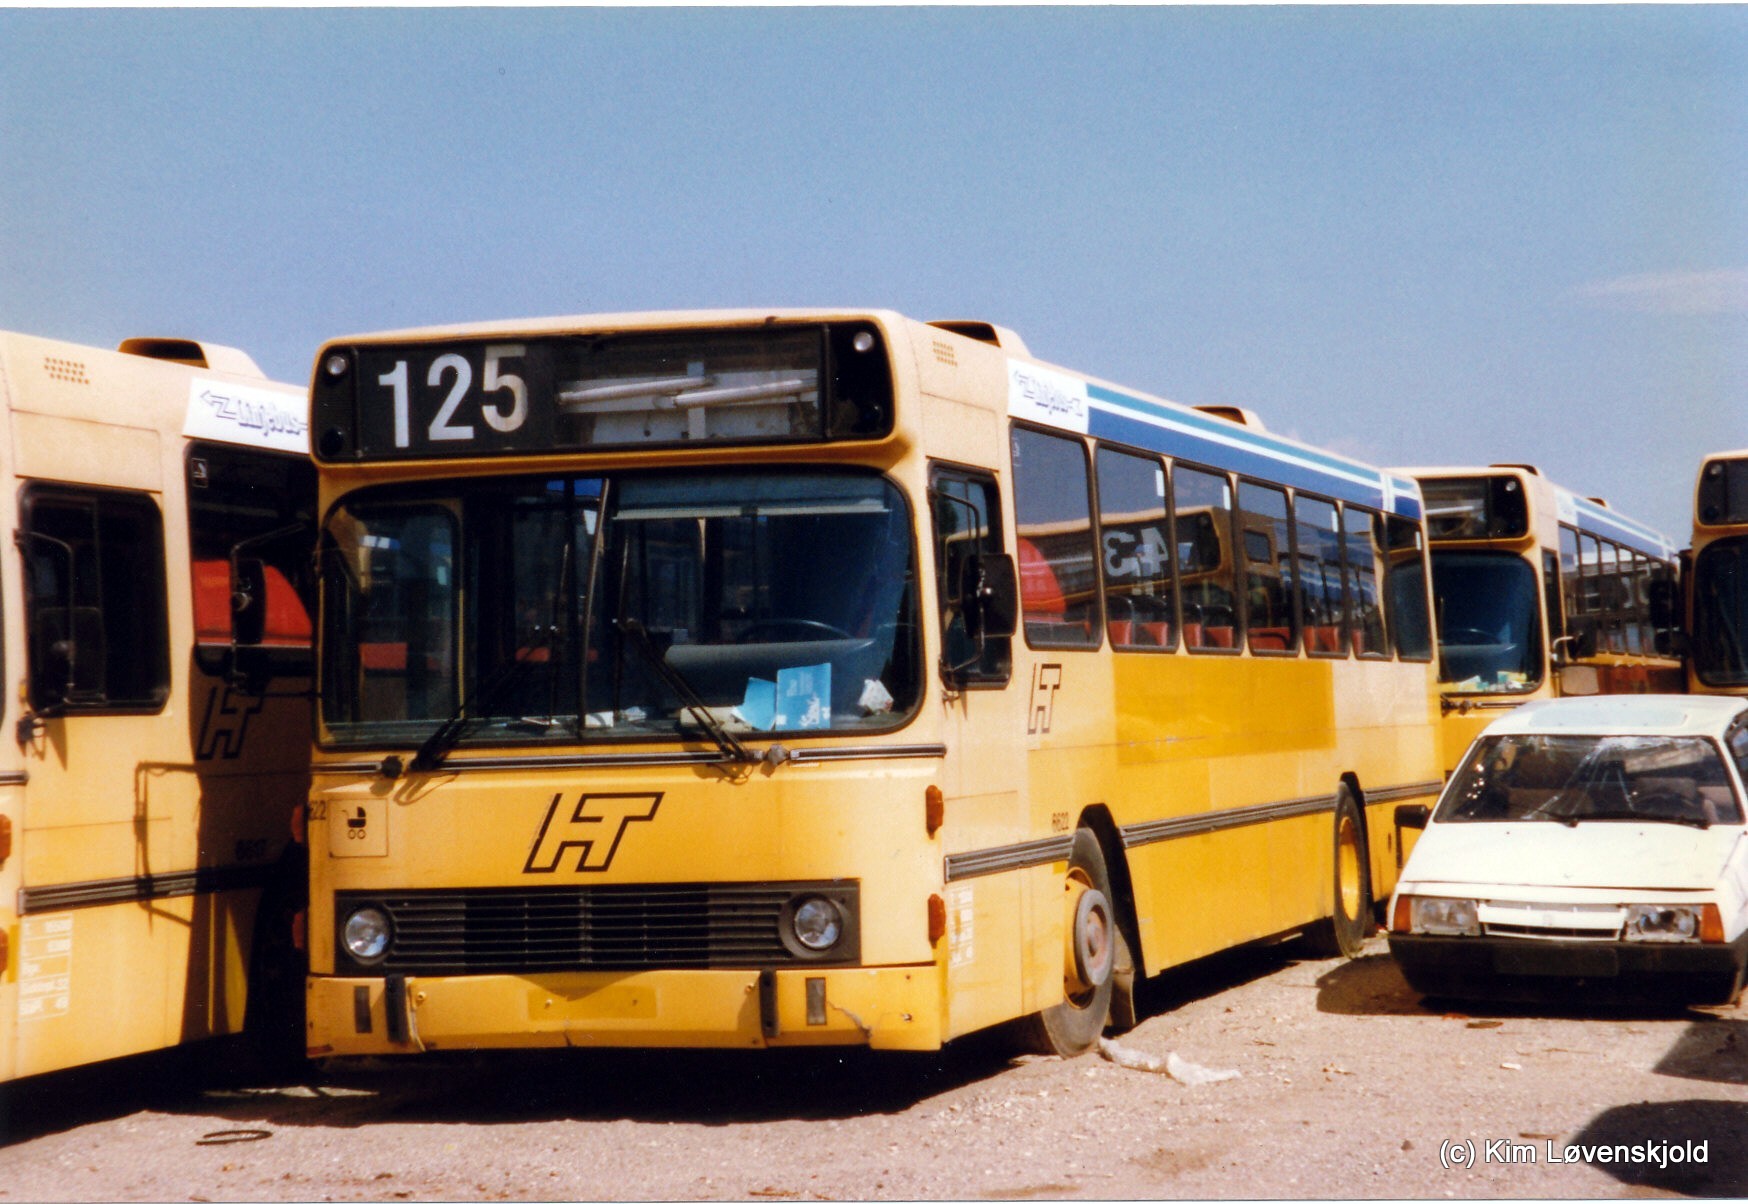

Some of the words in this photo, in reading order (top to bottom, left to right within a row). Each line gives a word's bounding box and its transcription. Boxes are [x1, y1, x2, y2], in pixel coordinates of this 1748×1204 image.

[378, 345, 528, 448] 125
[1027, 663, 1062, 735] HT
[523, 791, 665, 874] HT
